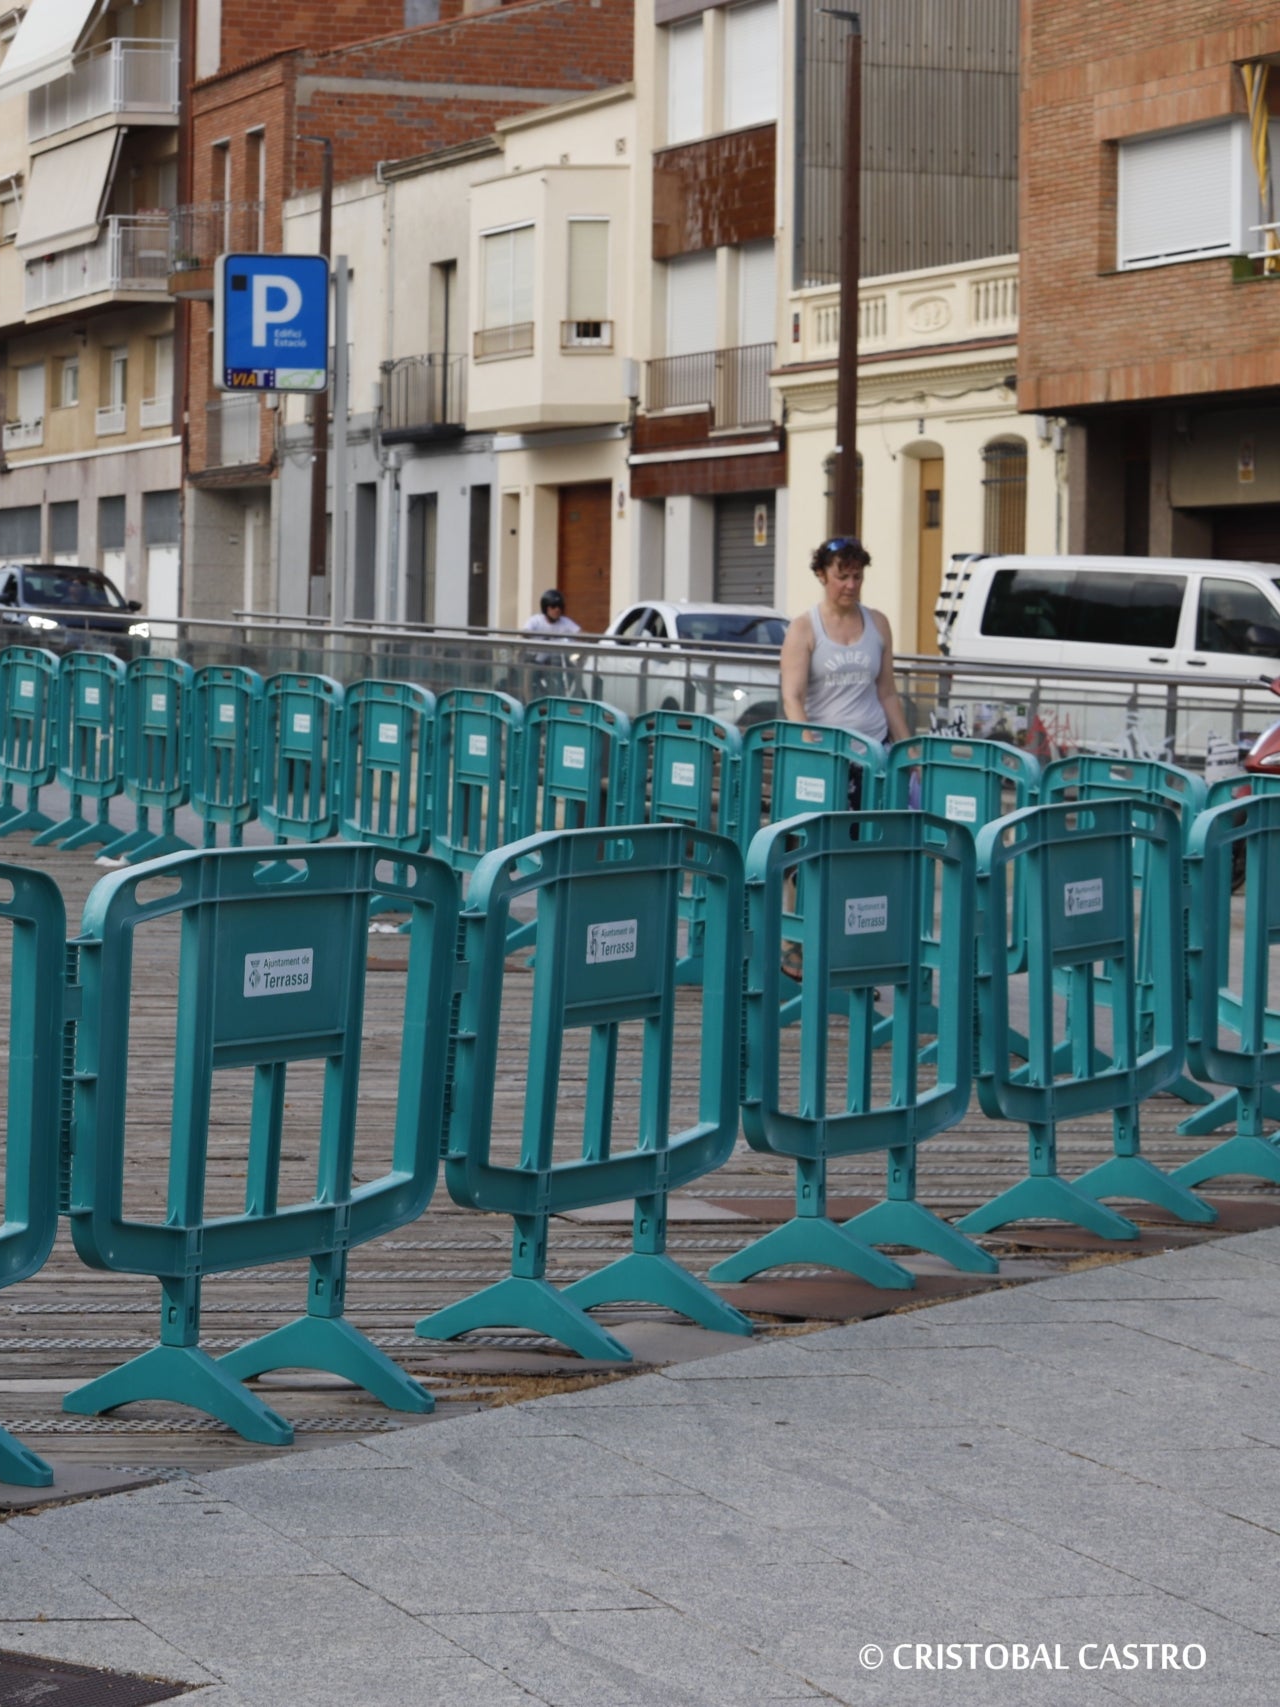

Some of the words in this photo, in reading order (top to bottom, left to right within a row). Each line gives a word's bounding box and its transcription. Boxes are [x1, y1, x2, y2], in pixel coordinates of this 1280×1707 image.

[252, 274, 303, 347] P
[273, 329, 302, 338] Edifici
[273, 338, 307, 348] Estació
[601, 941, 635, 956] Terrassa
[263, 957, 300, 970] Ajuntament
[301, 955, 310, 965] de
[263, 972, 309, 989] Terrassa
